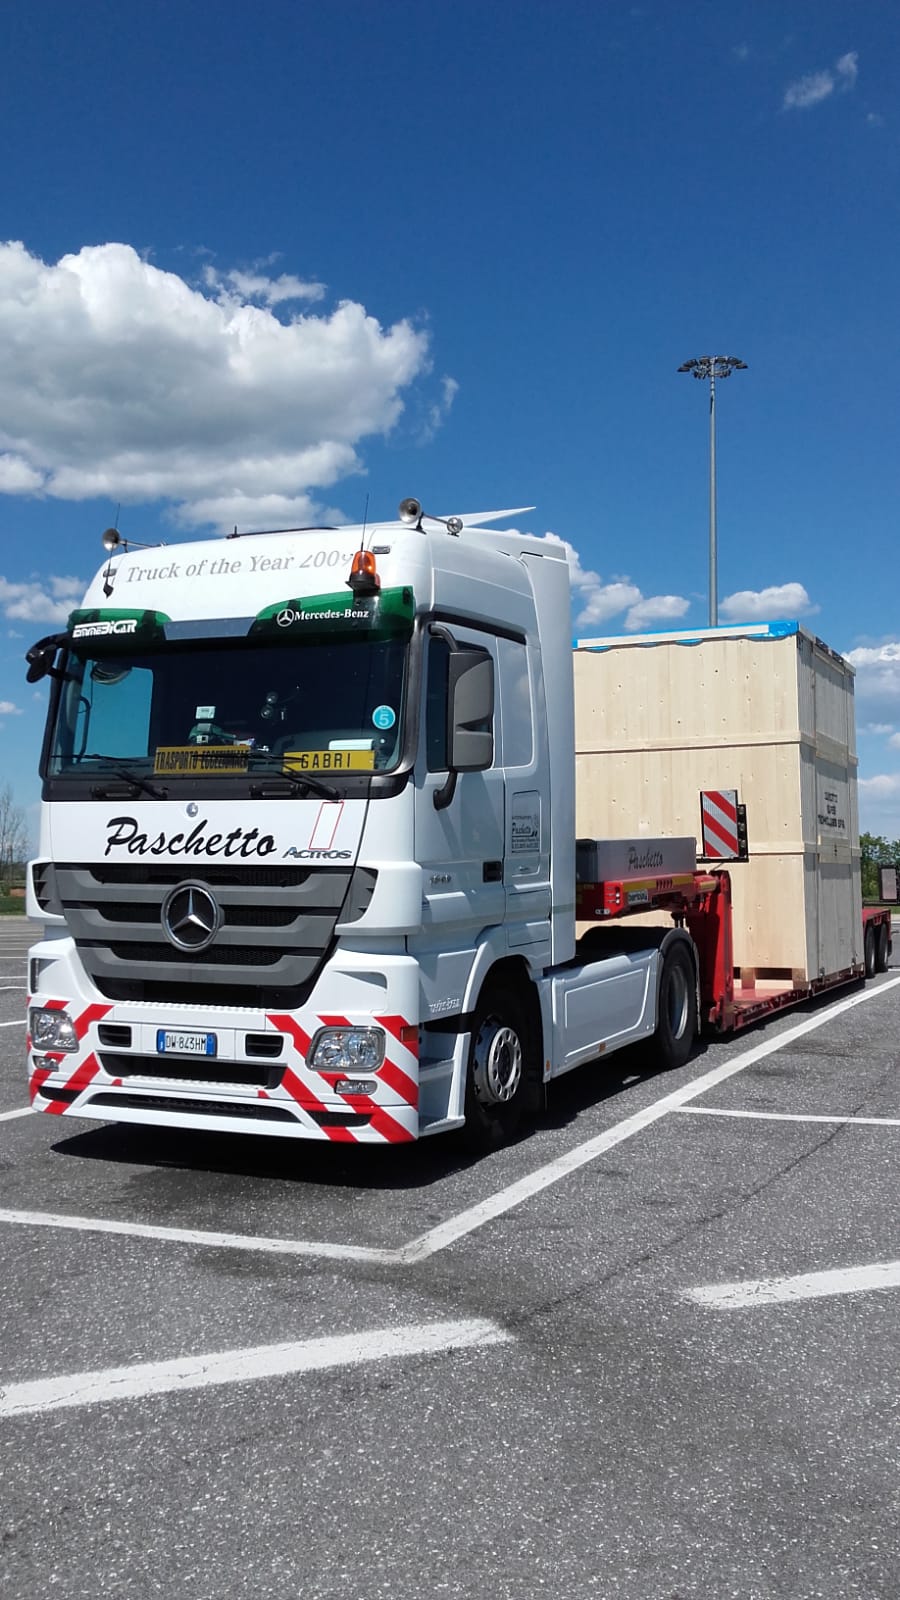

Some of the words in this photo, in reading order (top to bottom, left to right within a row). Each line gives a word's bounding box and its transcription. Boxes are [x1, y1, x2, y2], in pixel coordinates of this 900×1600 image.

[126, 565, 180, 583] Truck
[186, 559, 208, 577] of
[210, 556, 242, 574] the
[248, 553, 293, 572] Year
[294, 607, 370, 622] Mercedes-Benz
[378, 713, 390, 727] 5
[156, 751, 198, 770] TRASPORTO
[300, 752, 352, 770] GABRI
[104, 816, 277, 858] Paschetto
